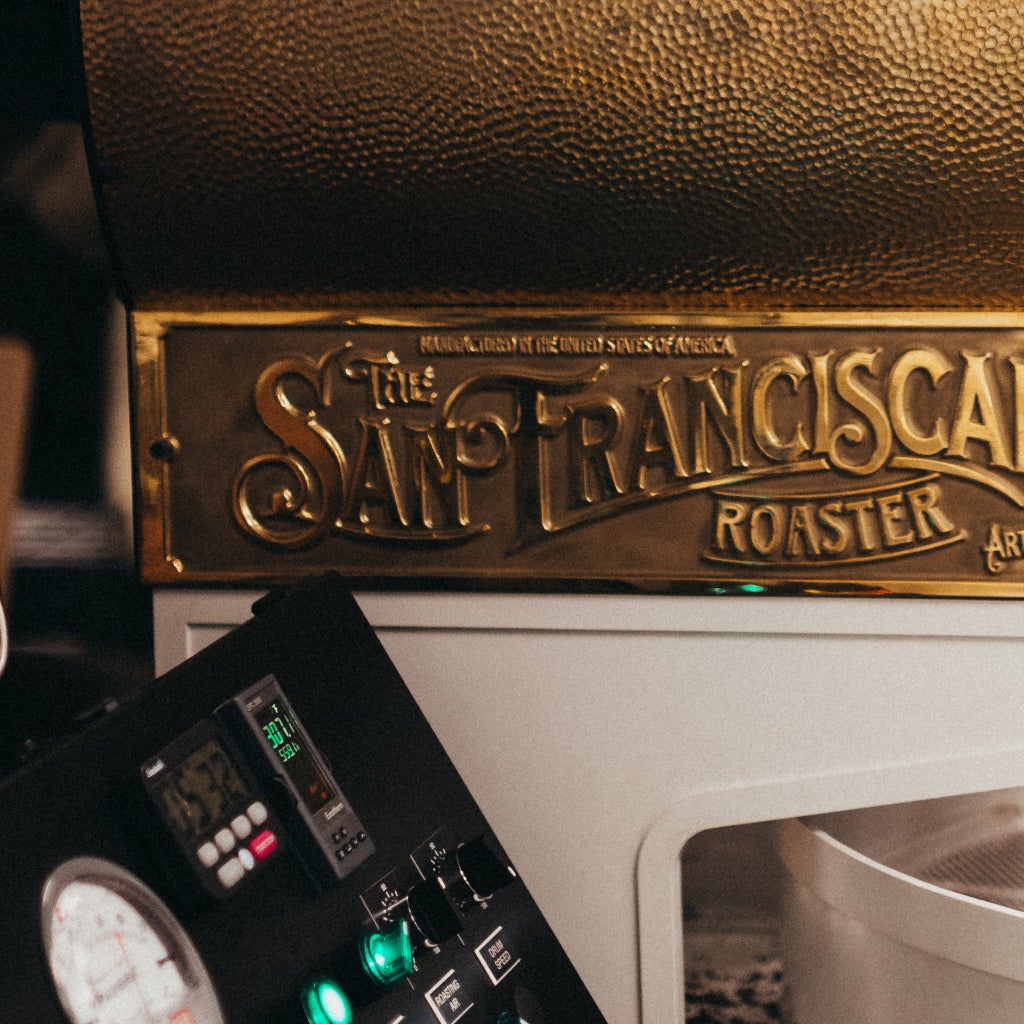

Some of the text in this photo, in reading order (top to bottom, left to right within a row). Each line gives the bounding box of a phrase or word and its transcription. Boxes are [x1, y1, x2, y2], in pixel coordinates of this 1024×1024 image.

[420, 335, 737, 356] MANUFACTURED IN THE UNITED STATES OF AMERICA
[345, 351, 437, 410] THE
[232, 342, 495, 544] SAN
[715, 484, 955, 555] ROASTER
[488, 939, 504, 958] DRUM
[494, 950, 511, 970] SPEED
[434, 979, 461, 1007] ROASTING
[449, 997, 461, 1012] AIR
